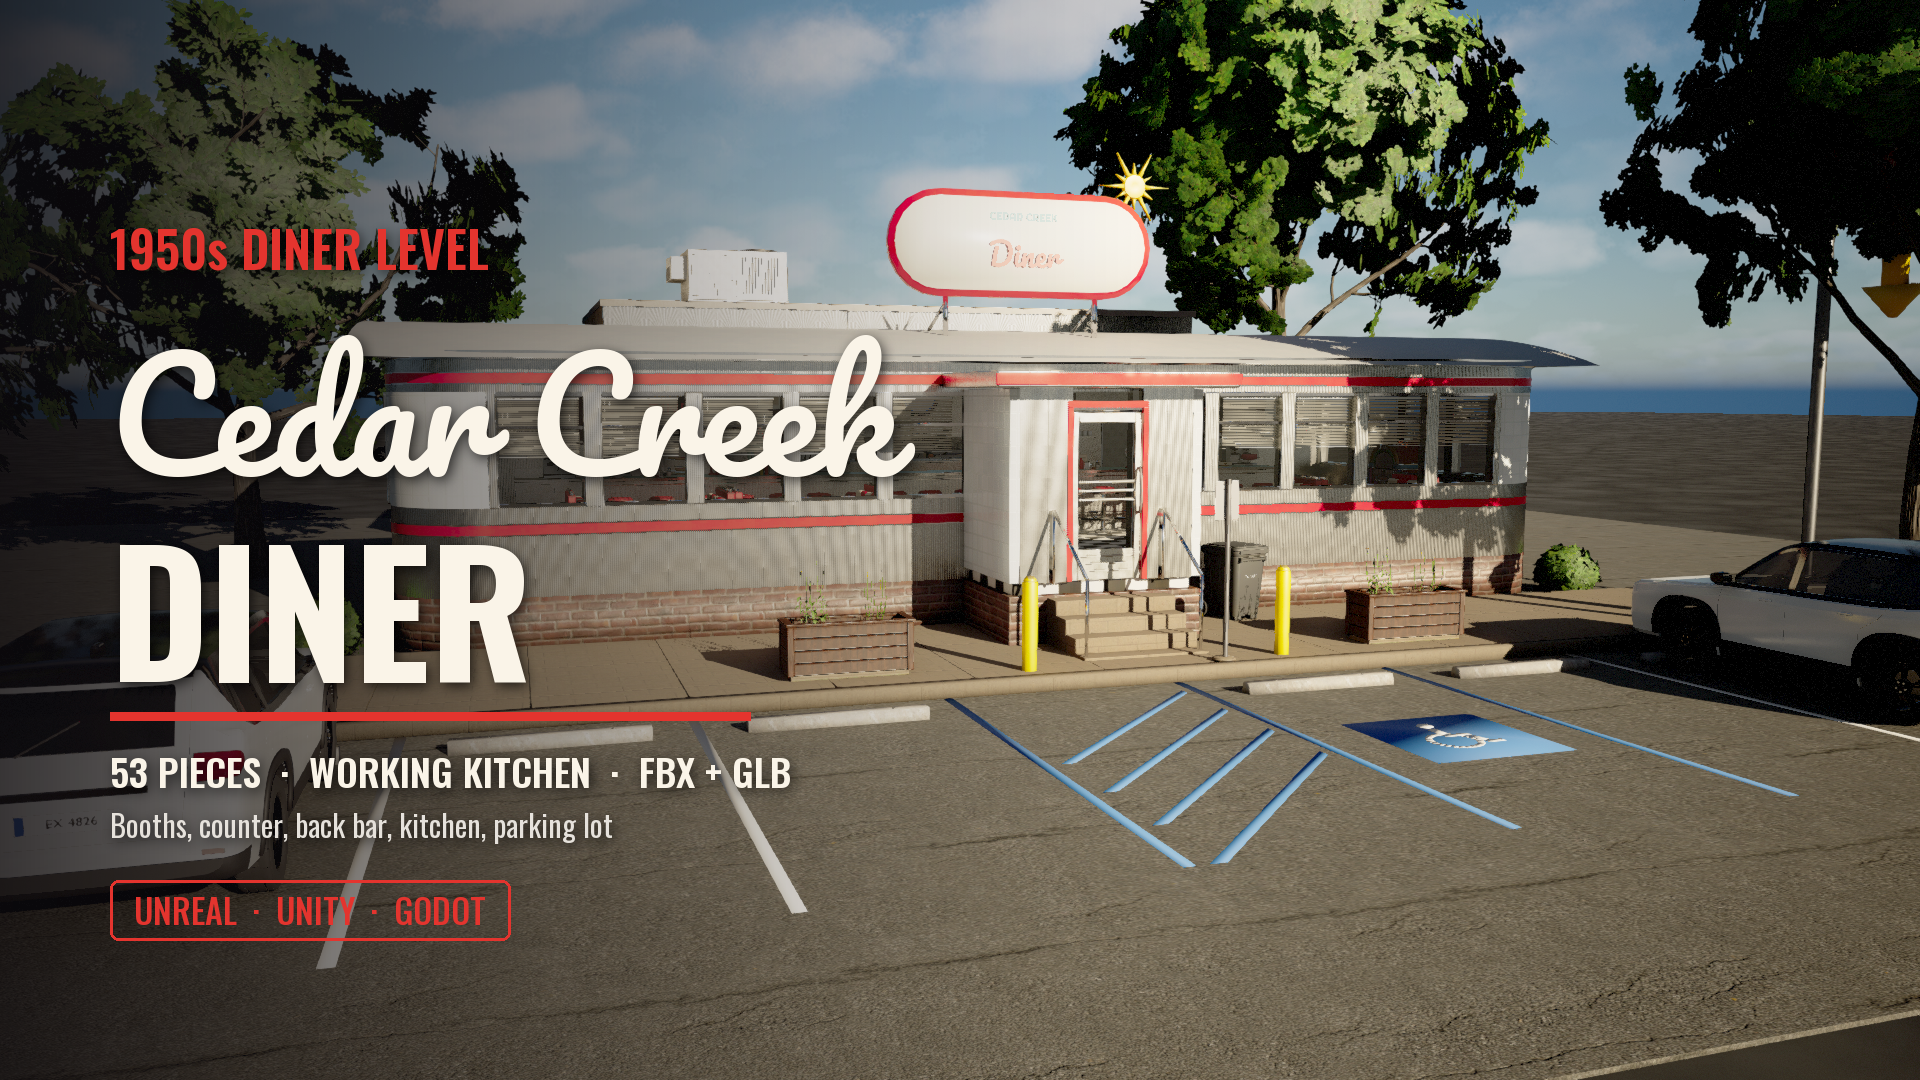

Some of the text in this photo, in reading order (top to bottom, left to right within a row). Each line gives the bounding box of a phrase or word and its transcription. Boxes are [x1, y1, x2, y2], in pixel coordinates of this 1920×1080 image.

[990, 212, 1058, 222] CEDAR CREEK
[989, 239, 1064, 268] Diner
[45, 816, 98, 829] EX 4826
